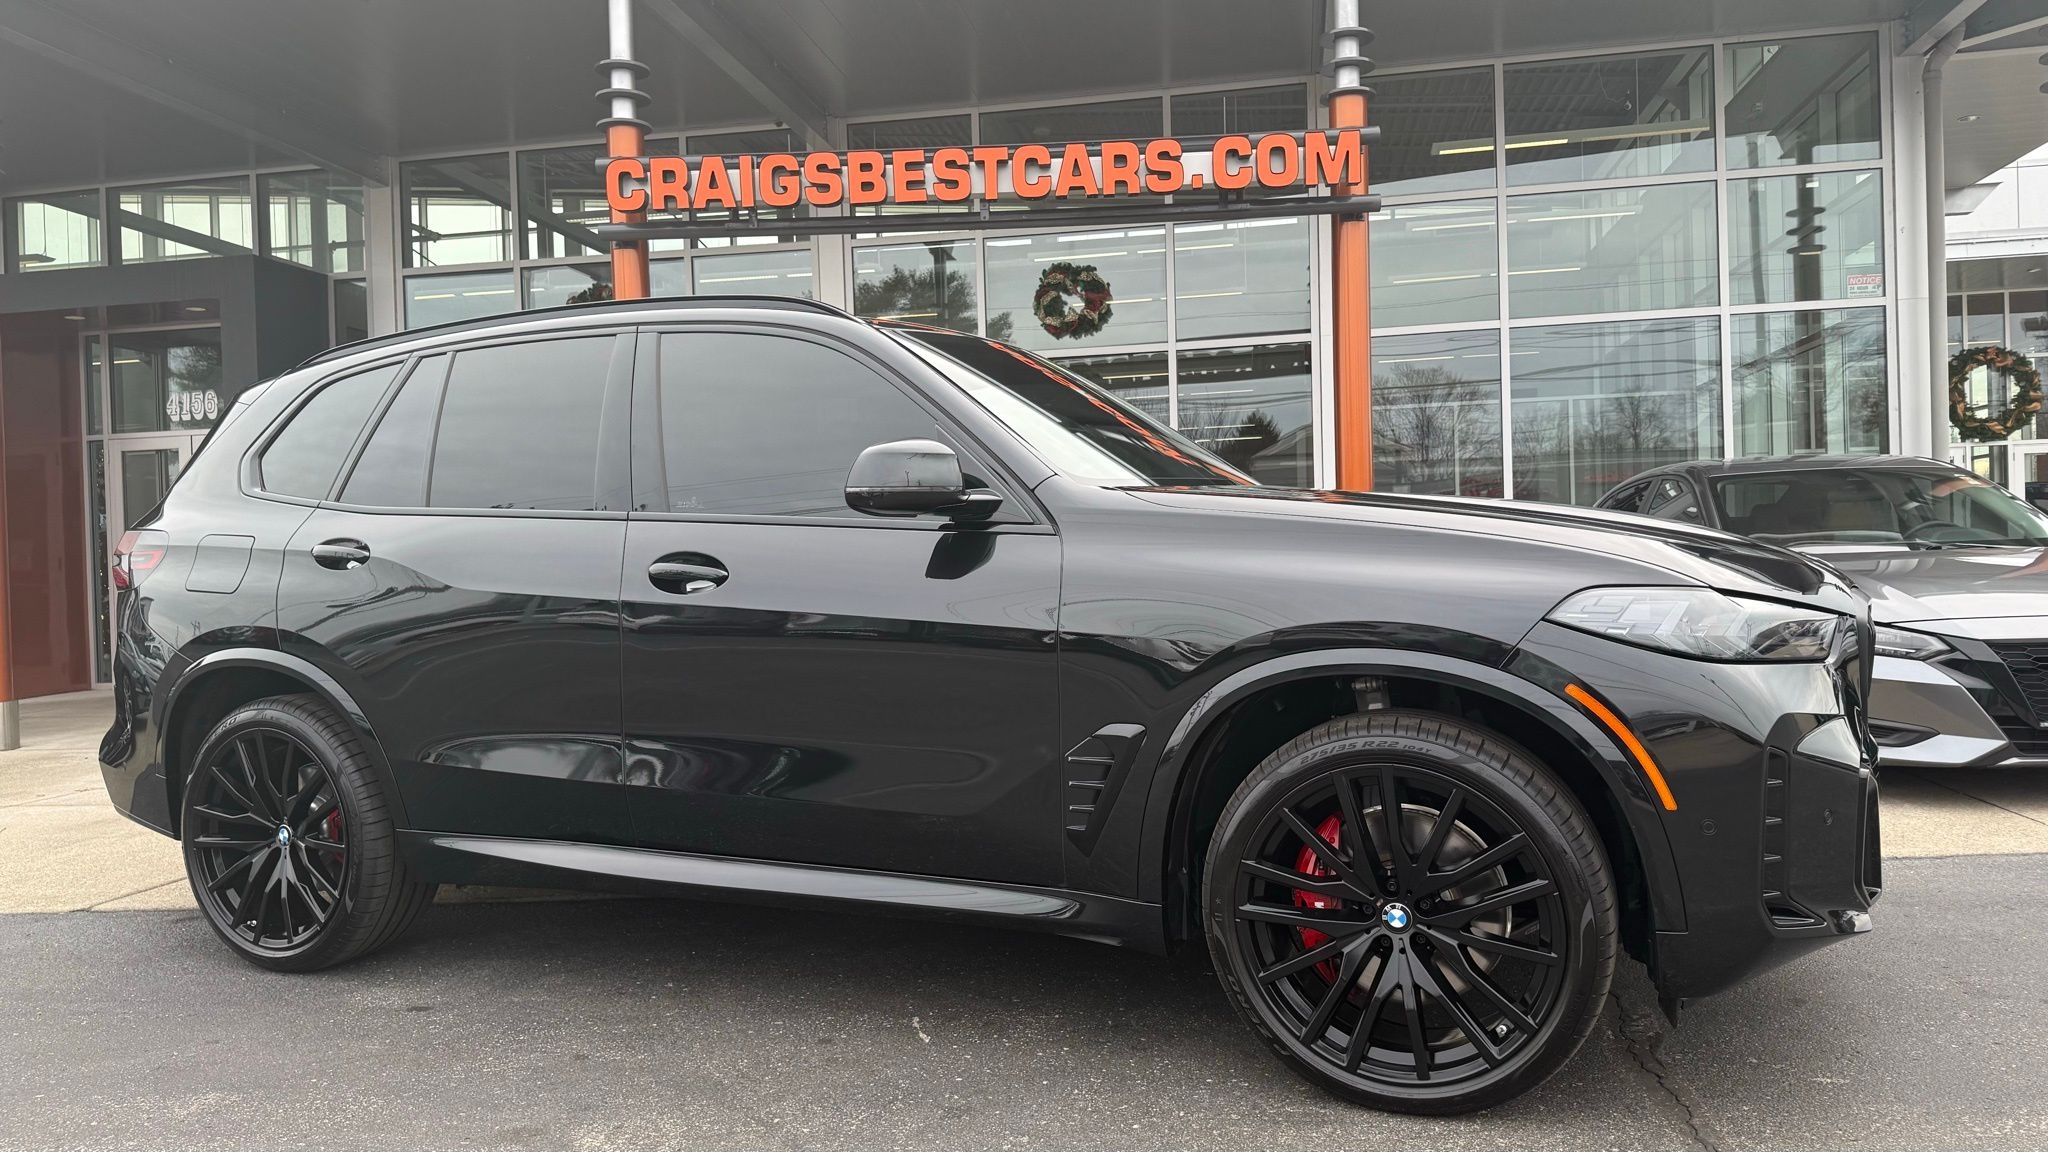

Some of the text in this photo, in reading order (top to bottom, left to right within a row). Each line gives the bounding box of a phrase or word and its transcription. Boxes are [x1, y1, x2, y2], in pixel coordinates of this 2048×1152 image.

[606, 130, 1361, 211] CRAIGSBESTCARS.COM
[1850, 276, 1882, 285] NOTICE
[166, 389, 218, 422] 4156
[1300, 741, 1358, 765] 275/35
[1361, 740, 1400, 748] R22
